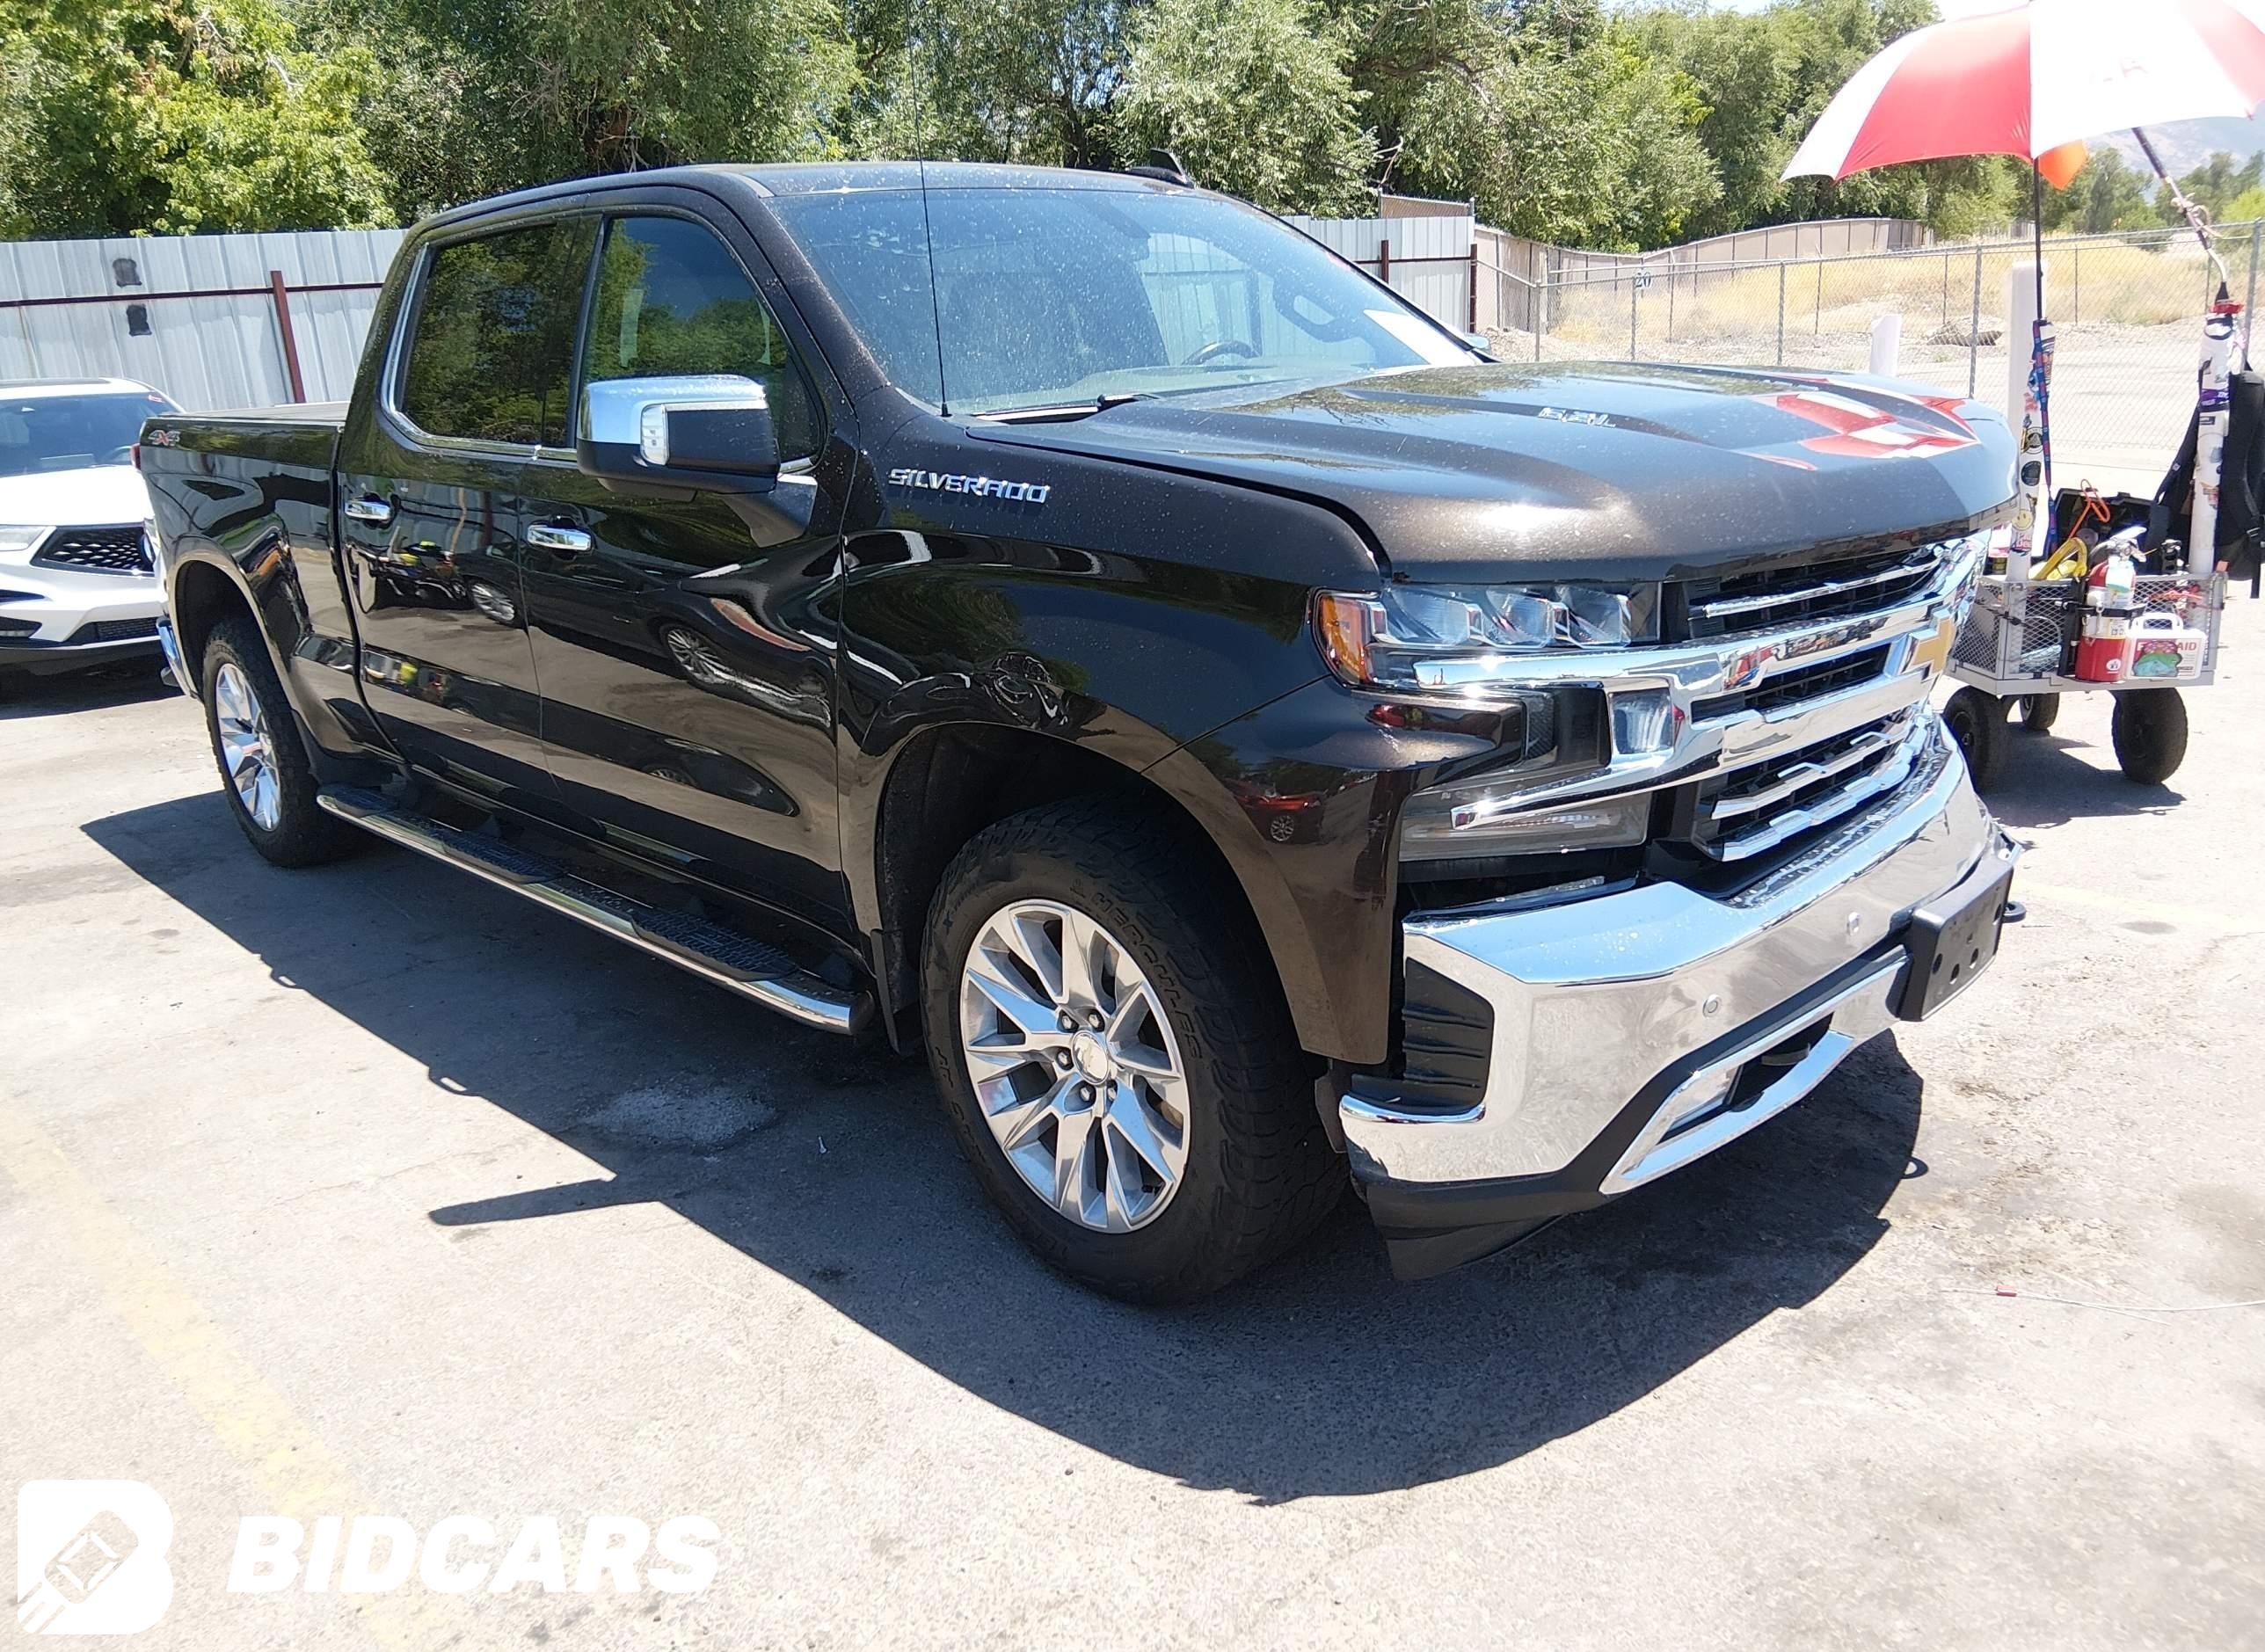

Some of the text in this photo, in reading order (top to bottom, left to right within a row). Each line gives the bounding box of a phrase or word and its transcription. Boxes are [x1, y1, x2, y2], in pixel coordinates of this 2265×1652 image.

[1635, 272, 1651, 287] 20
[888, 469, 1051, 504] SILVERADO
[2178, 642, 2196, 651] AID
[1091, 892, 1203, 1059] HERCULES
